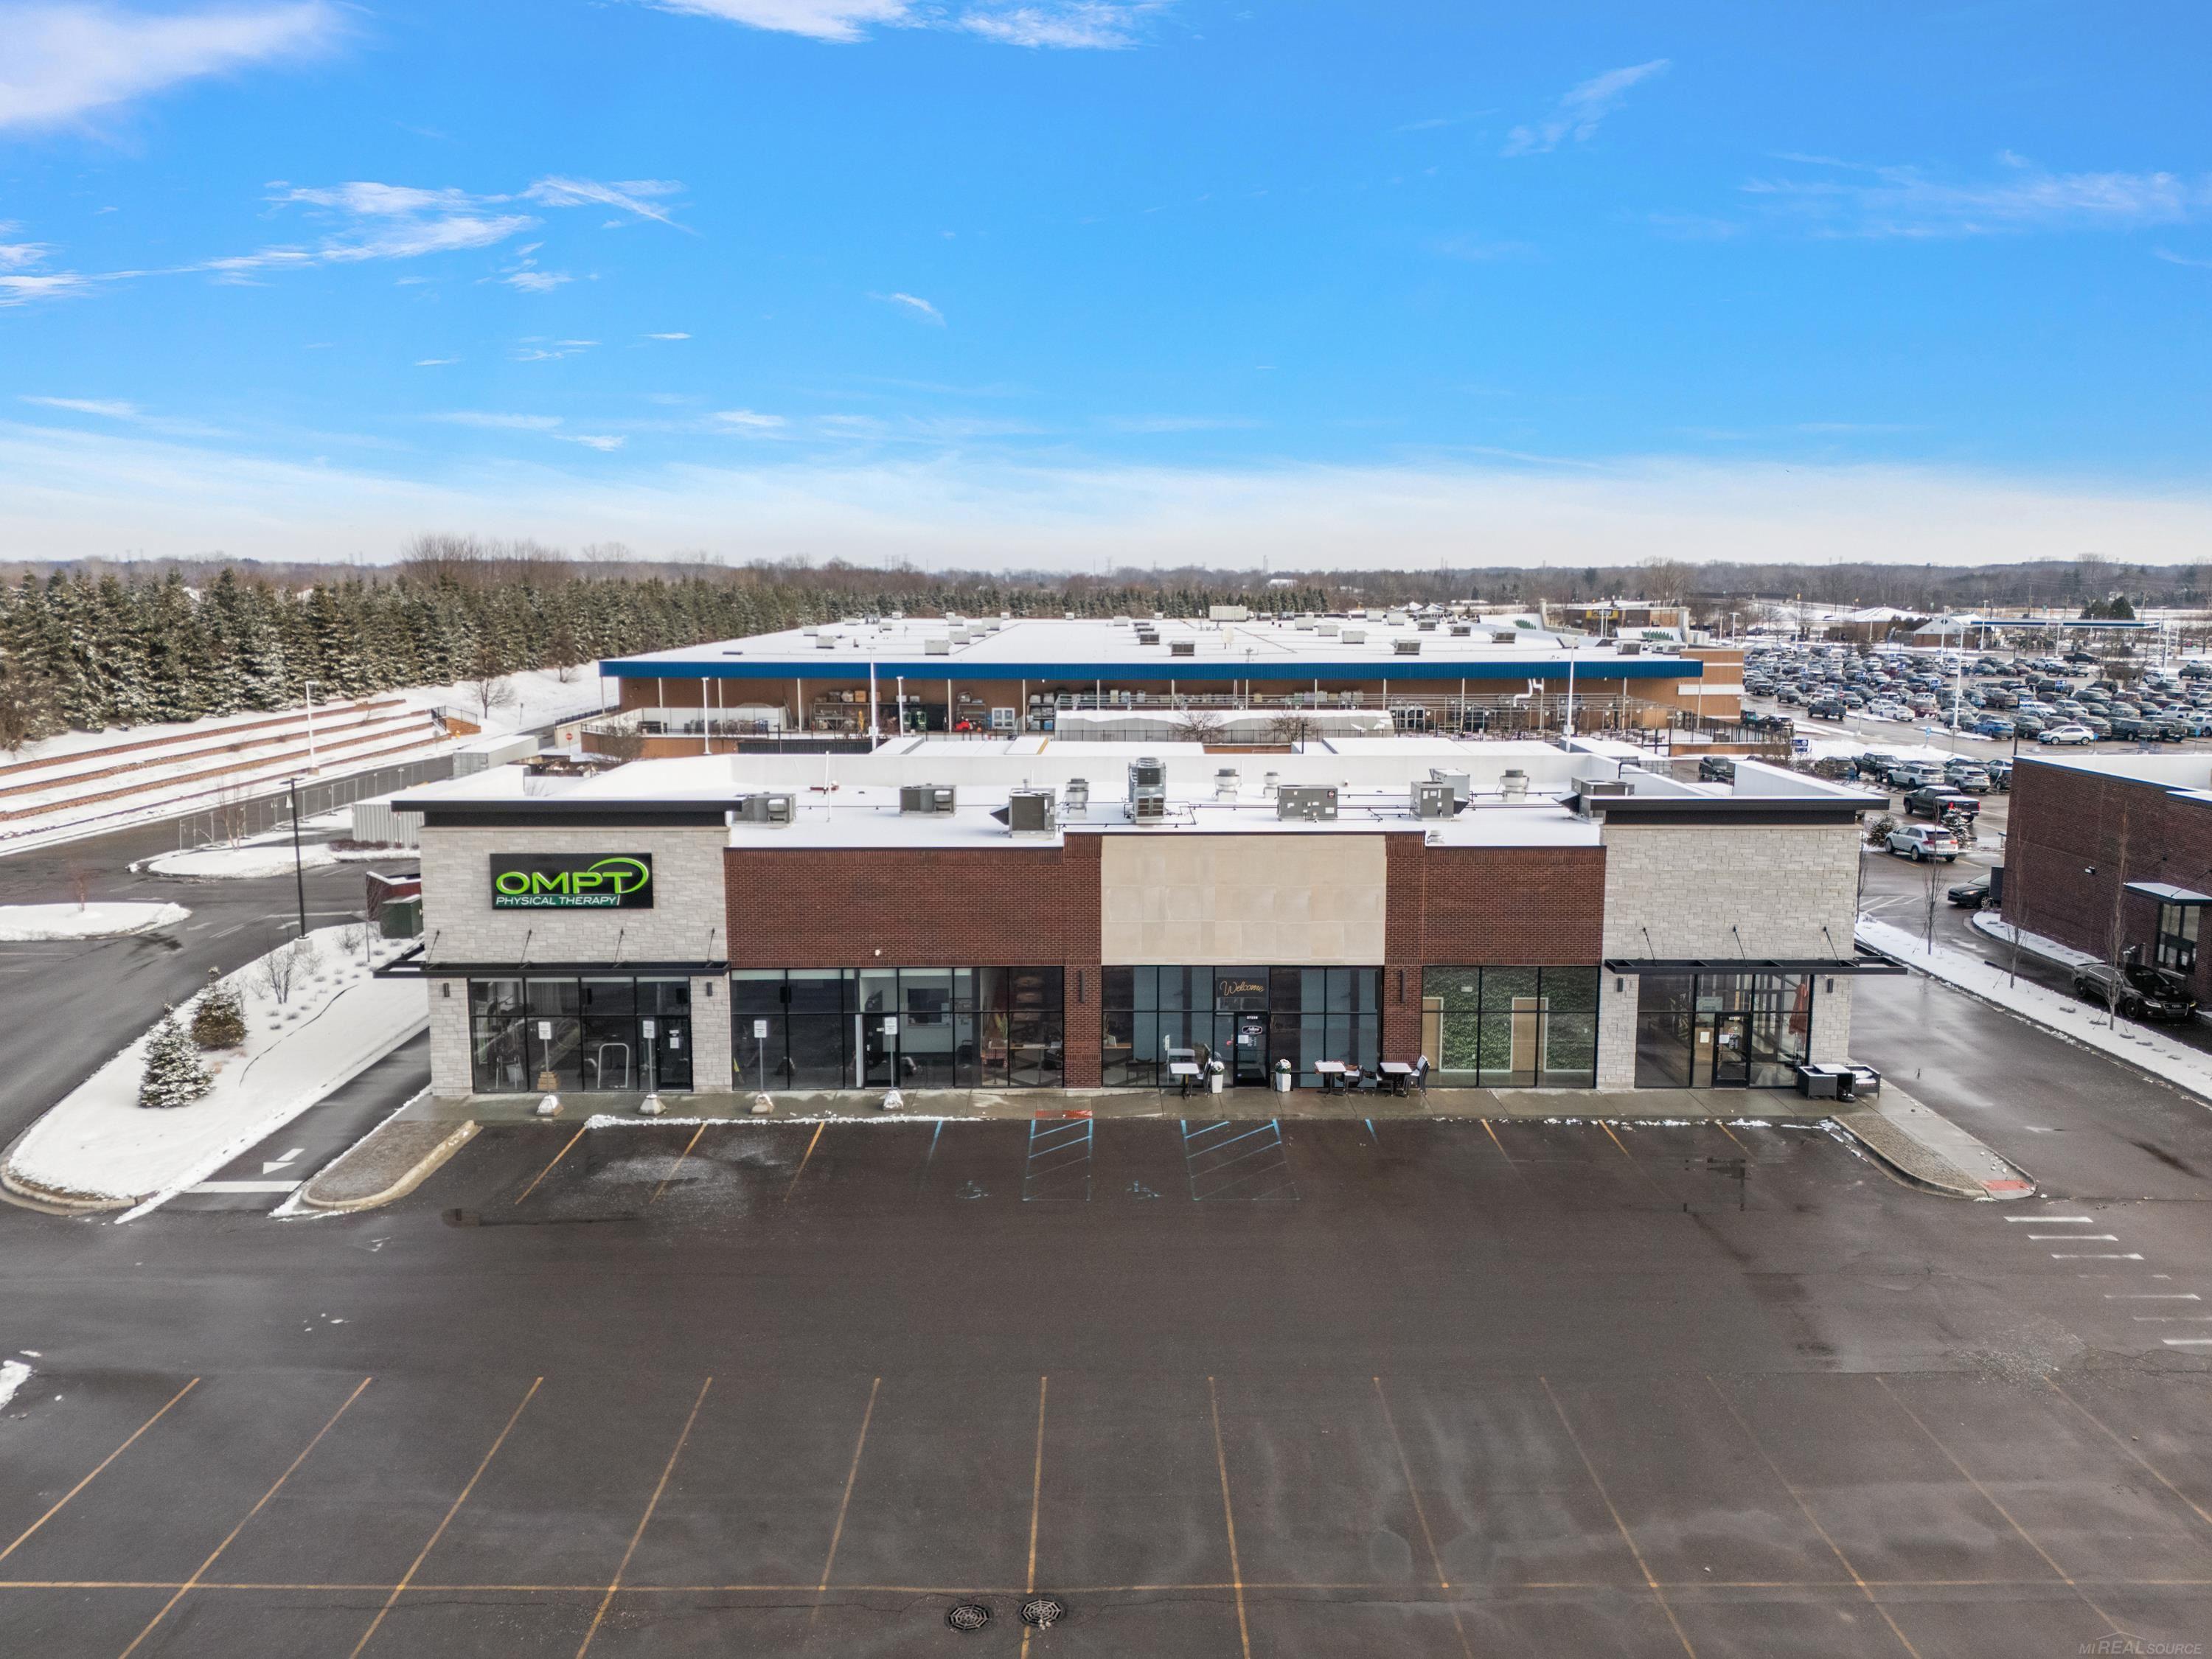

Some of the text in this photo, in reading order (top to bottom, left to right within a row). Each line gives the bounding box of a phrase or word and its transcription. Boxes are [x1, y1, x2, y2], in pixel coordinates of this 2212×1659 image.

[495, 872, 633, 894] OMPT
[496, 897, 616, 905] PHYSICAL THERAPY
[1220, 981, 1265, 996] Welcome
